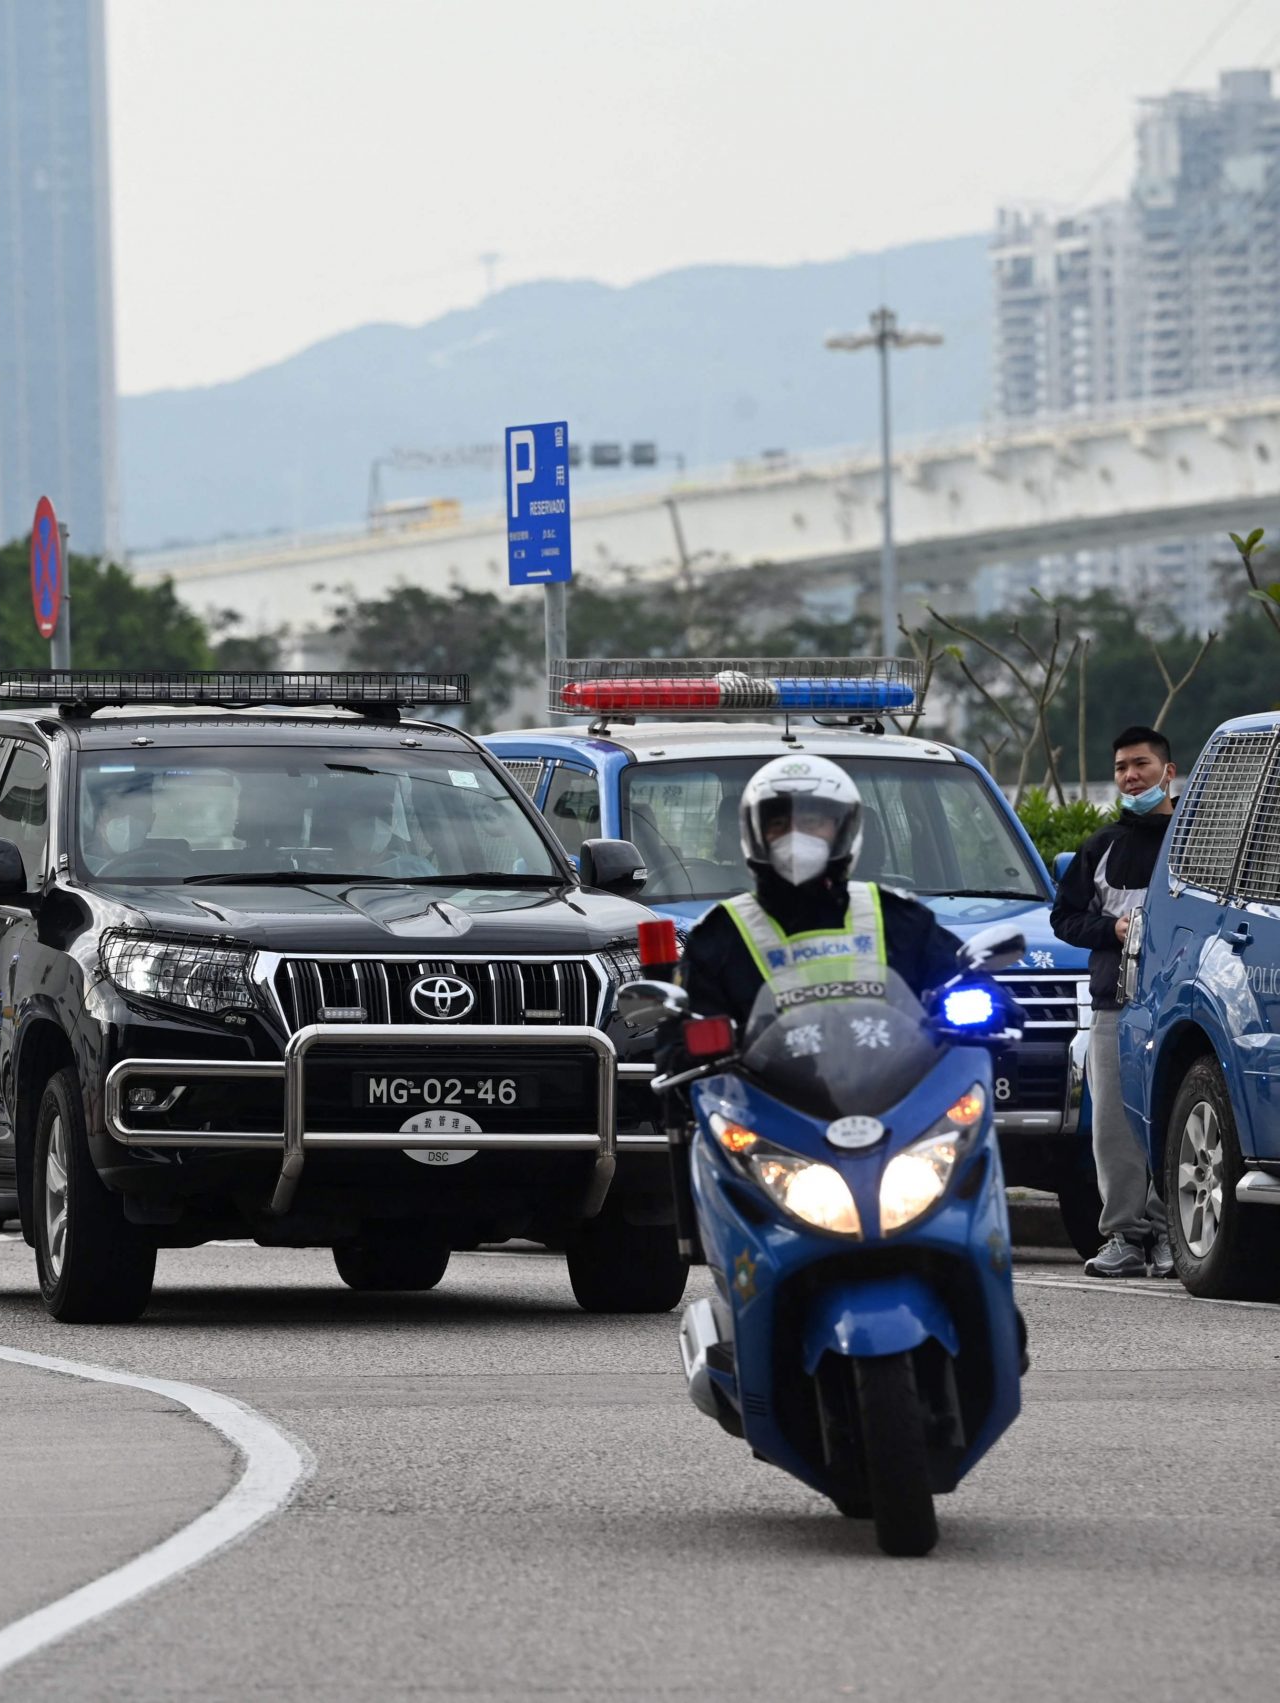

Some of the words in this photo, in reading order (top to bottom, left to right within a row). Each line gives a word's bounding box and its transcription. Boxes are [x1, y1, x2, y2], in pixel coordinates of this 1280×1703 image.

[510, 430, 535, 518] P
[529, 499, 565, 515] RESERVADO
[792, 942, 851, 962] POLÍCIA
[774, 983, 885, 1008] MC-02-30
[369, 1078, 517, 1105] MG-02-46
[427, 1151, 449, 1162] DSC
